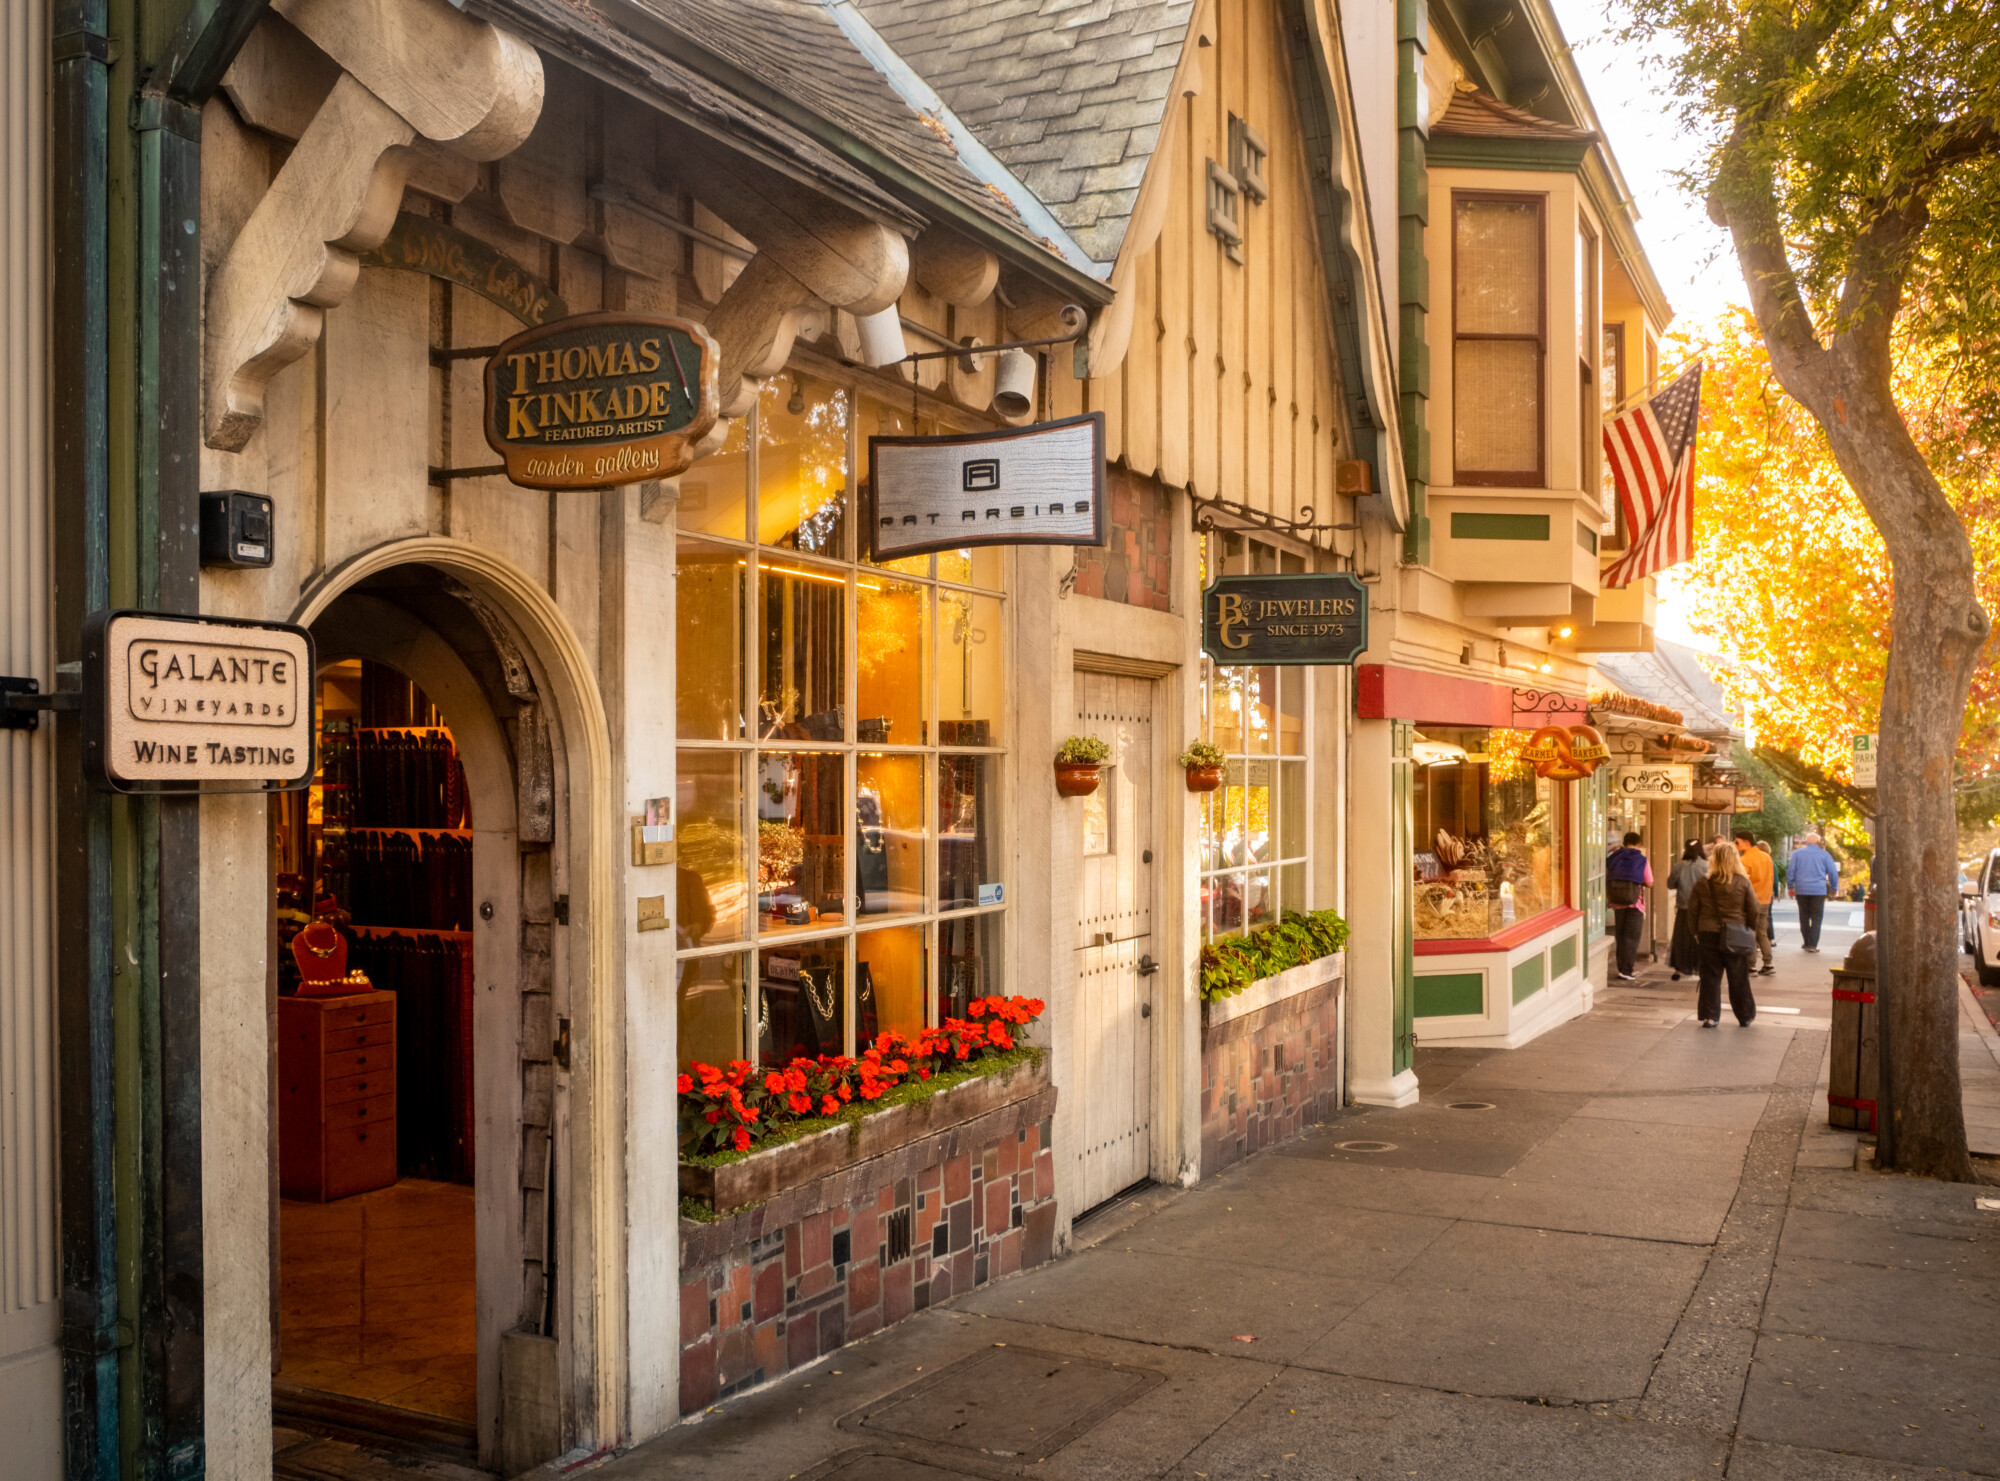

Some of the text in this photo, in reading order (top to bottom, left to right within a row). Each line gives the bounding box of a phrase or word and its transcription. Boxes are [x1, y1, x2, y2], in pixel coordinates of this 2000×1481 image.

[507, 338, 661, 395] THOMAS
[506, 381, 671, 439] KINKADE
[545, 419, 666, 442] FEATURED ARTIST
[523, 446, 660, 479] garden gallery
[880, 500, 1090, 528] PAT AREIAS
[1256, 598, 1355, 621] JEWELERS
[1267, 624, 1344, 637] SINCE 1973
[140, 649, 287, 688] GALANTE
[140, 697, 285, 717] VINEYARDS
[133, 740, 295, 765] WINE TASTING
[1524, 745, 1604, 758] CARMEL BAKERY
[1856, 737, 1866, 749] 2
[1855, 753, 1876, 763] PARK
